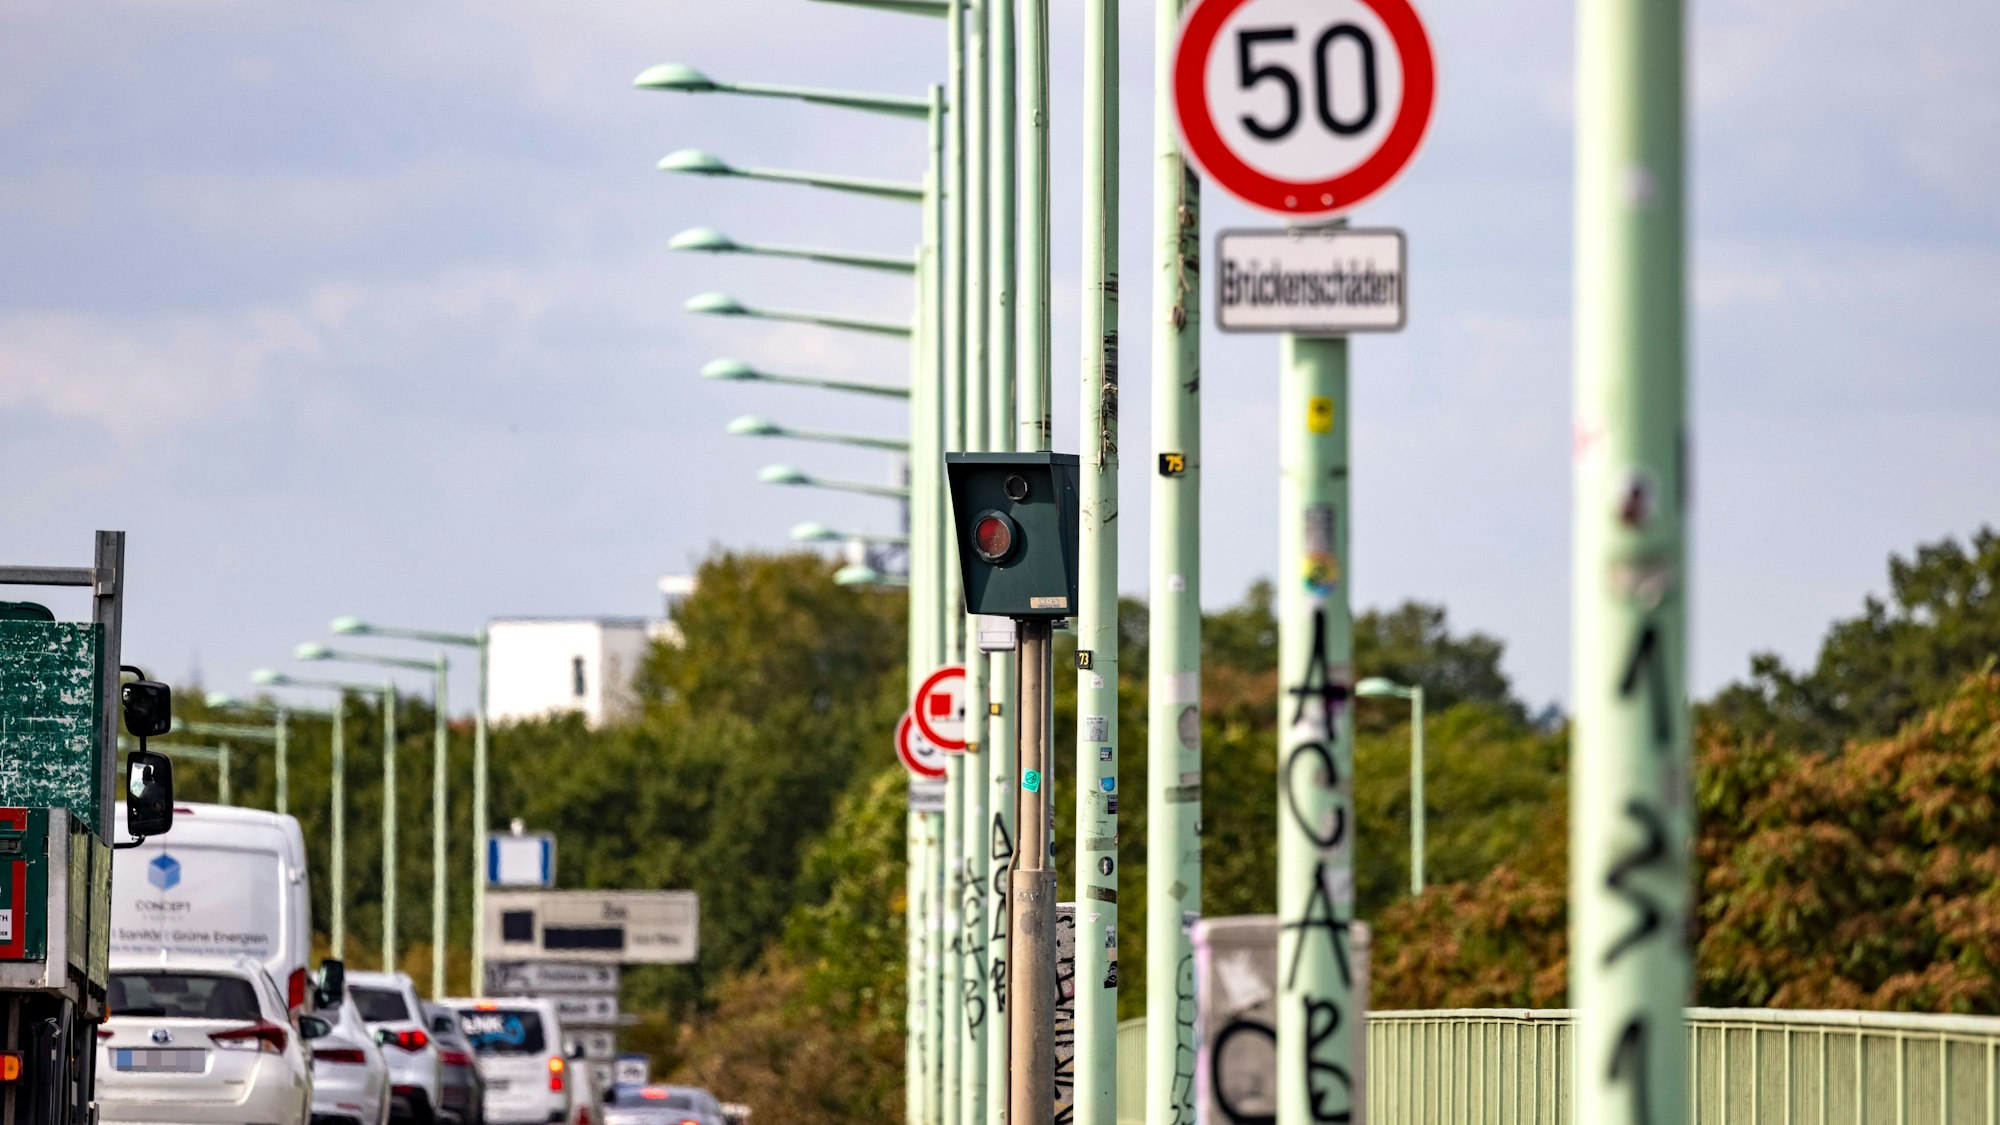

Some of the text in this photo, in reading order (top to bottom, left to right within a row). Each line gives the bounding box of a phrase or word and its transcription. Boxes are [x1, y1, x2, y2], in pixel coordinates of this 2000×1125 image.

[1236, 21, 1379, 144] 50
[1221, 256, 1400, 306] Brückenschäden
[1165, 455, 1184, 472] 75
[1079, 652, 1089, 665] 73
[135, 901, 191, 913] CONCEPT
[173, 930, 211, 942] Grüne
[213, 930, 269, 946] Energien
